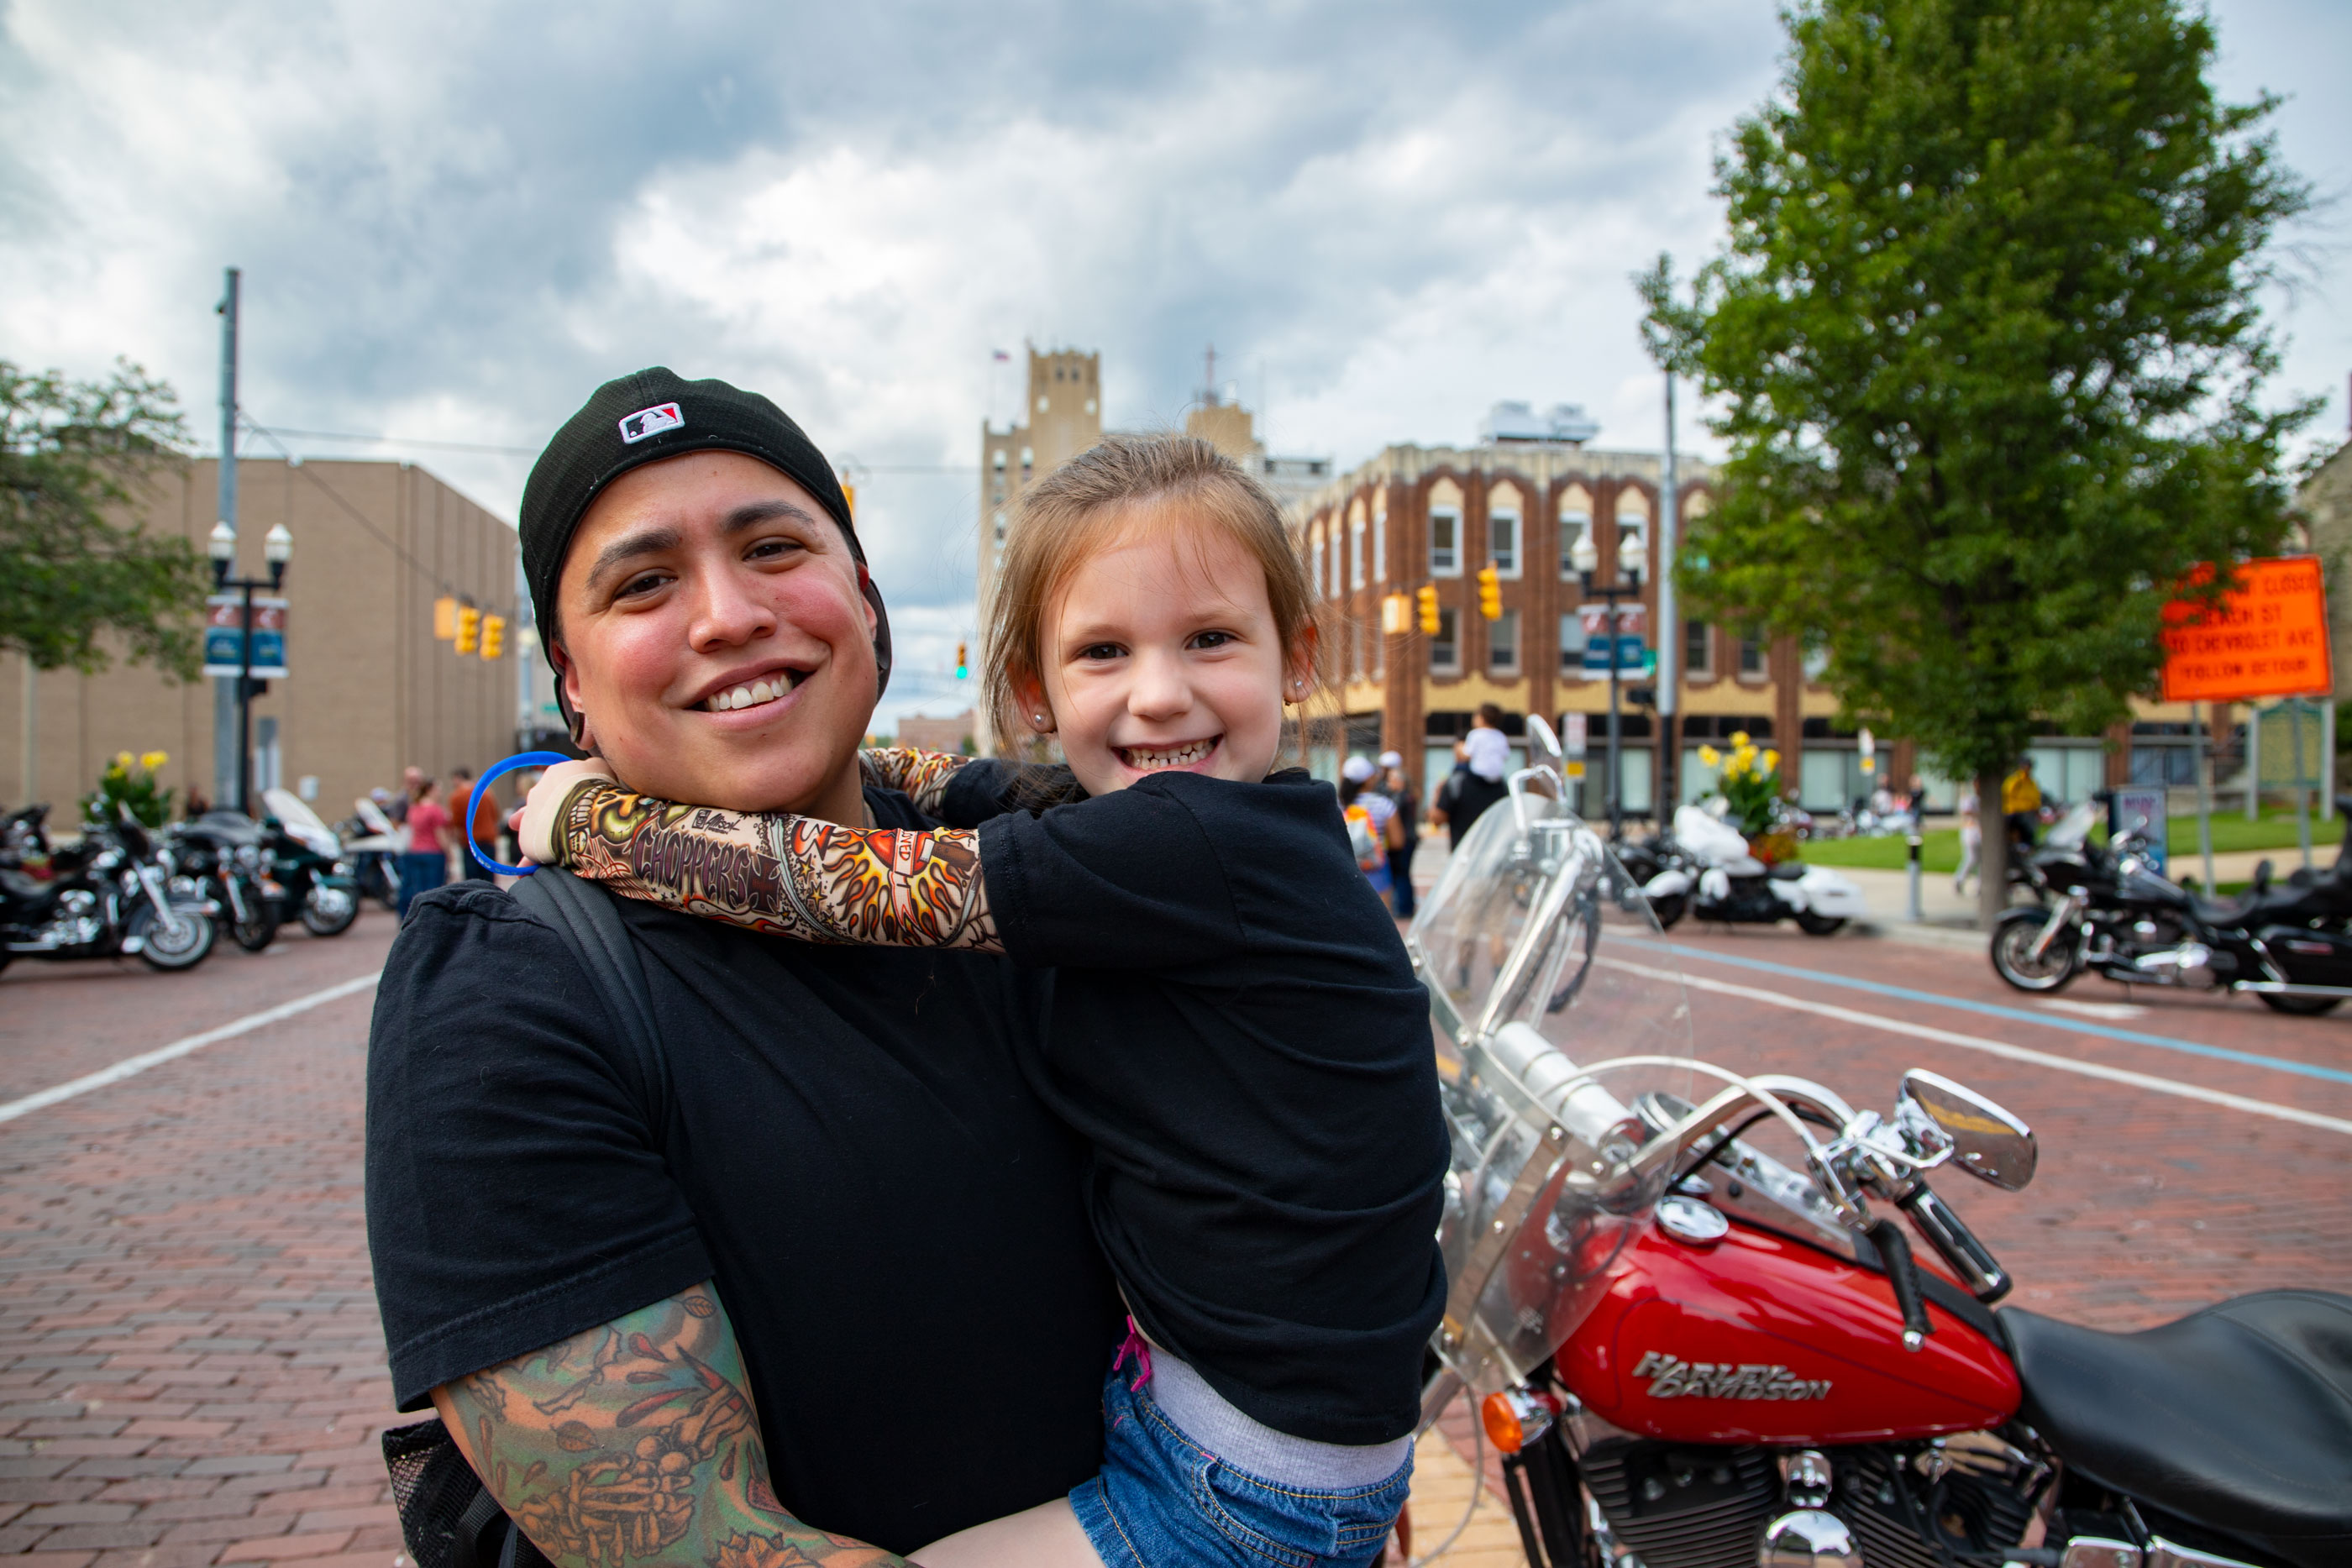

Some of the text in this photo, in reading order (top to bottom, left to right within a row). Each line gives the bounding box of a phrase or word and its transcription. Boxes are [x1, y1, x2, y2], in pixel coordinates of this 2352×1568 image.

[2260, 602, 2282, 624] ST
[2195, 628, 2280, 655] CHEVROLET
[2286, 627, 2315, 648] AVE
[2181, 655, 2308, 681] FOLLOW DETOUR
[633, 825, 752, 910] CHOPPERS
[1646, 1379, 1833, 1401] DAVIDSON
